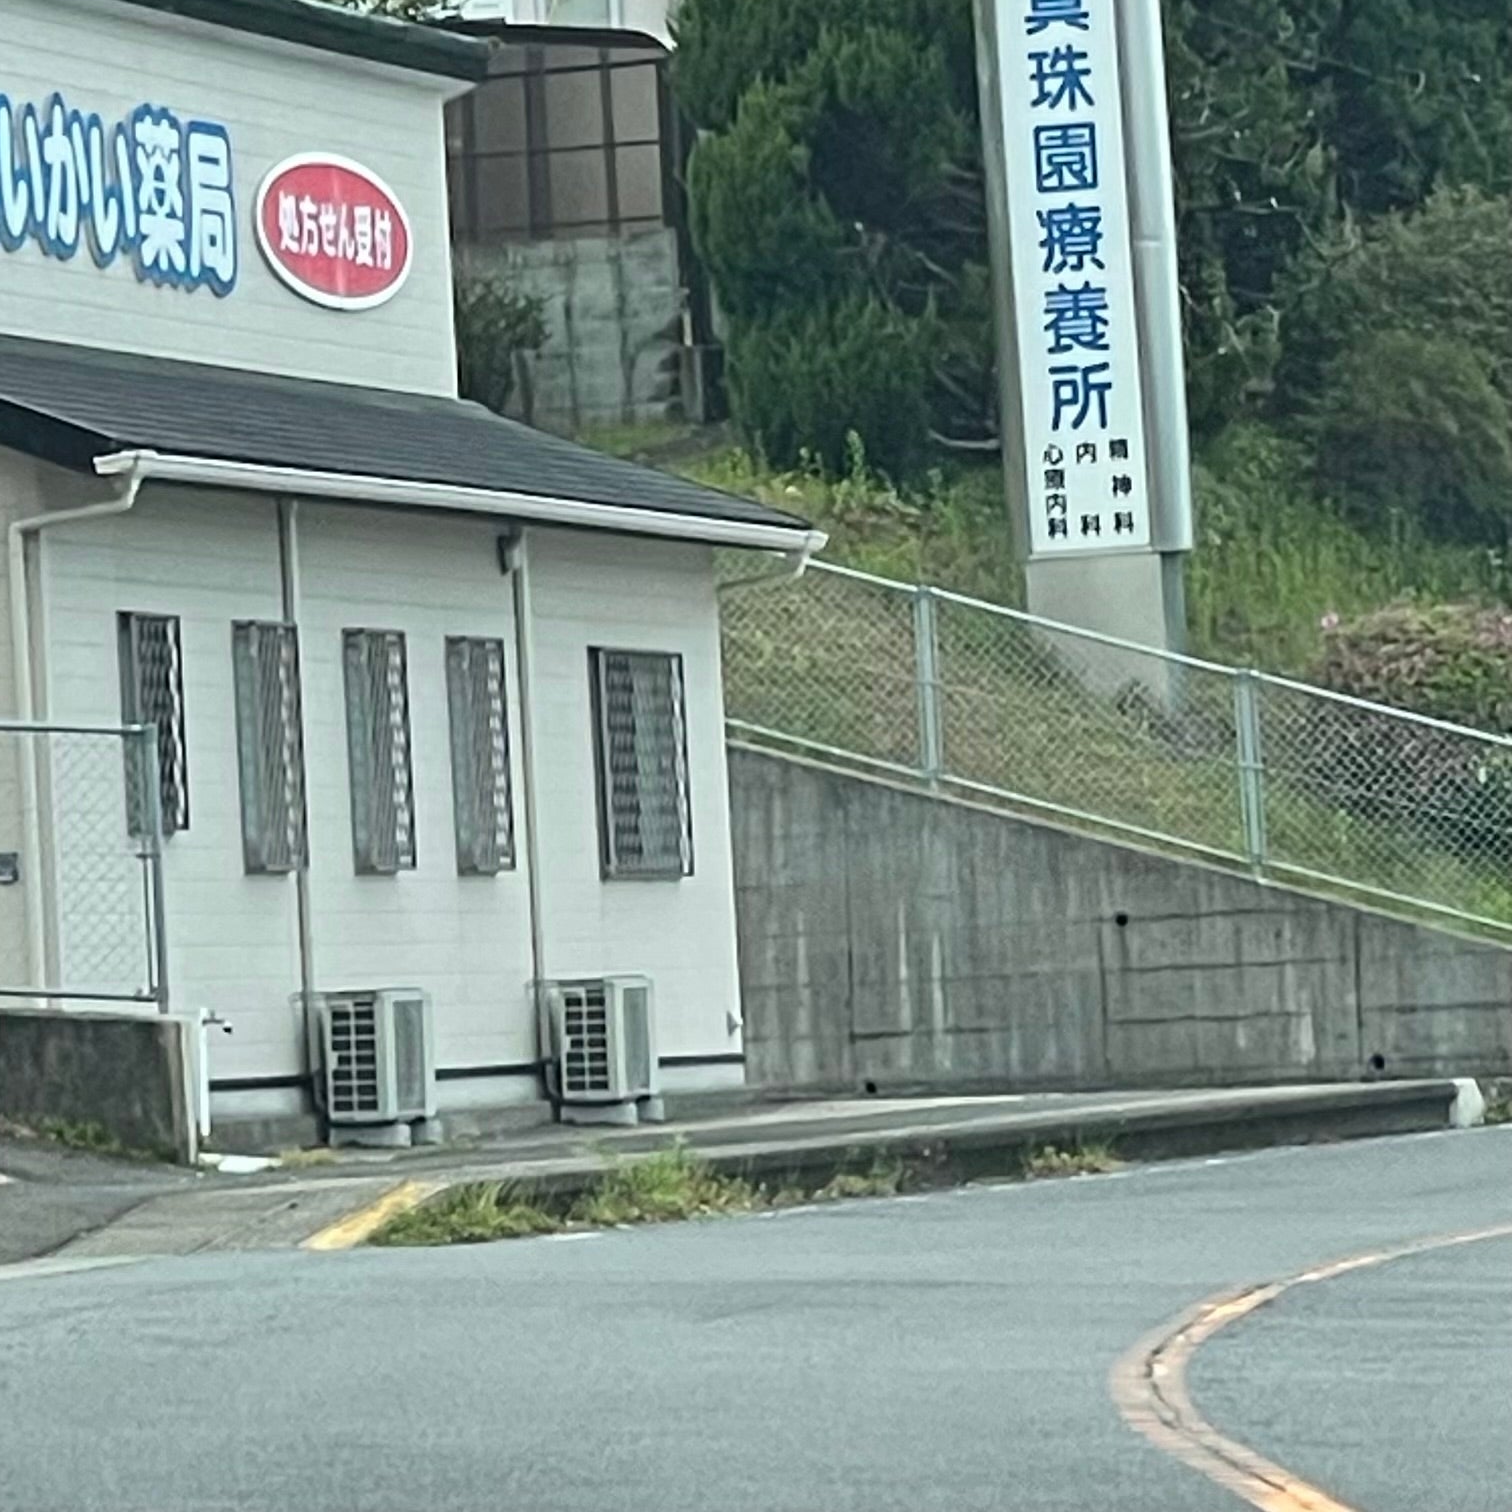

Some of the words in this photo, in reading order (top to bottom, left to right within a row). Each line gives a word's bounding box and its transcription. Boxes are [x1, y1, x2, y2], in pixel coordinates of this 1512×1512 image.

[279, 189, 392, 270] 処方せん受付
